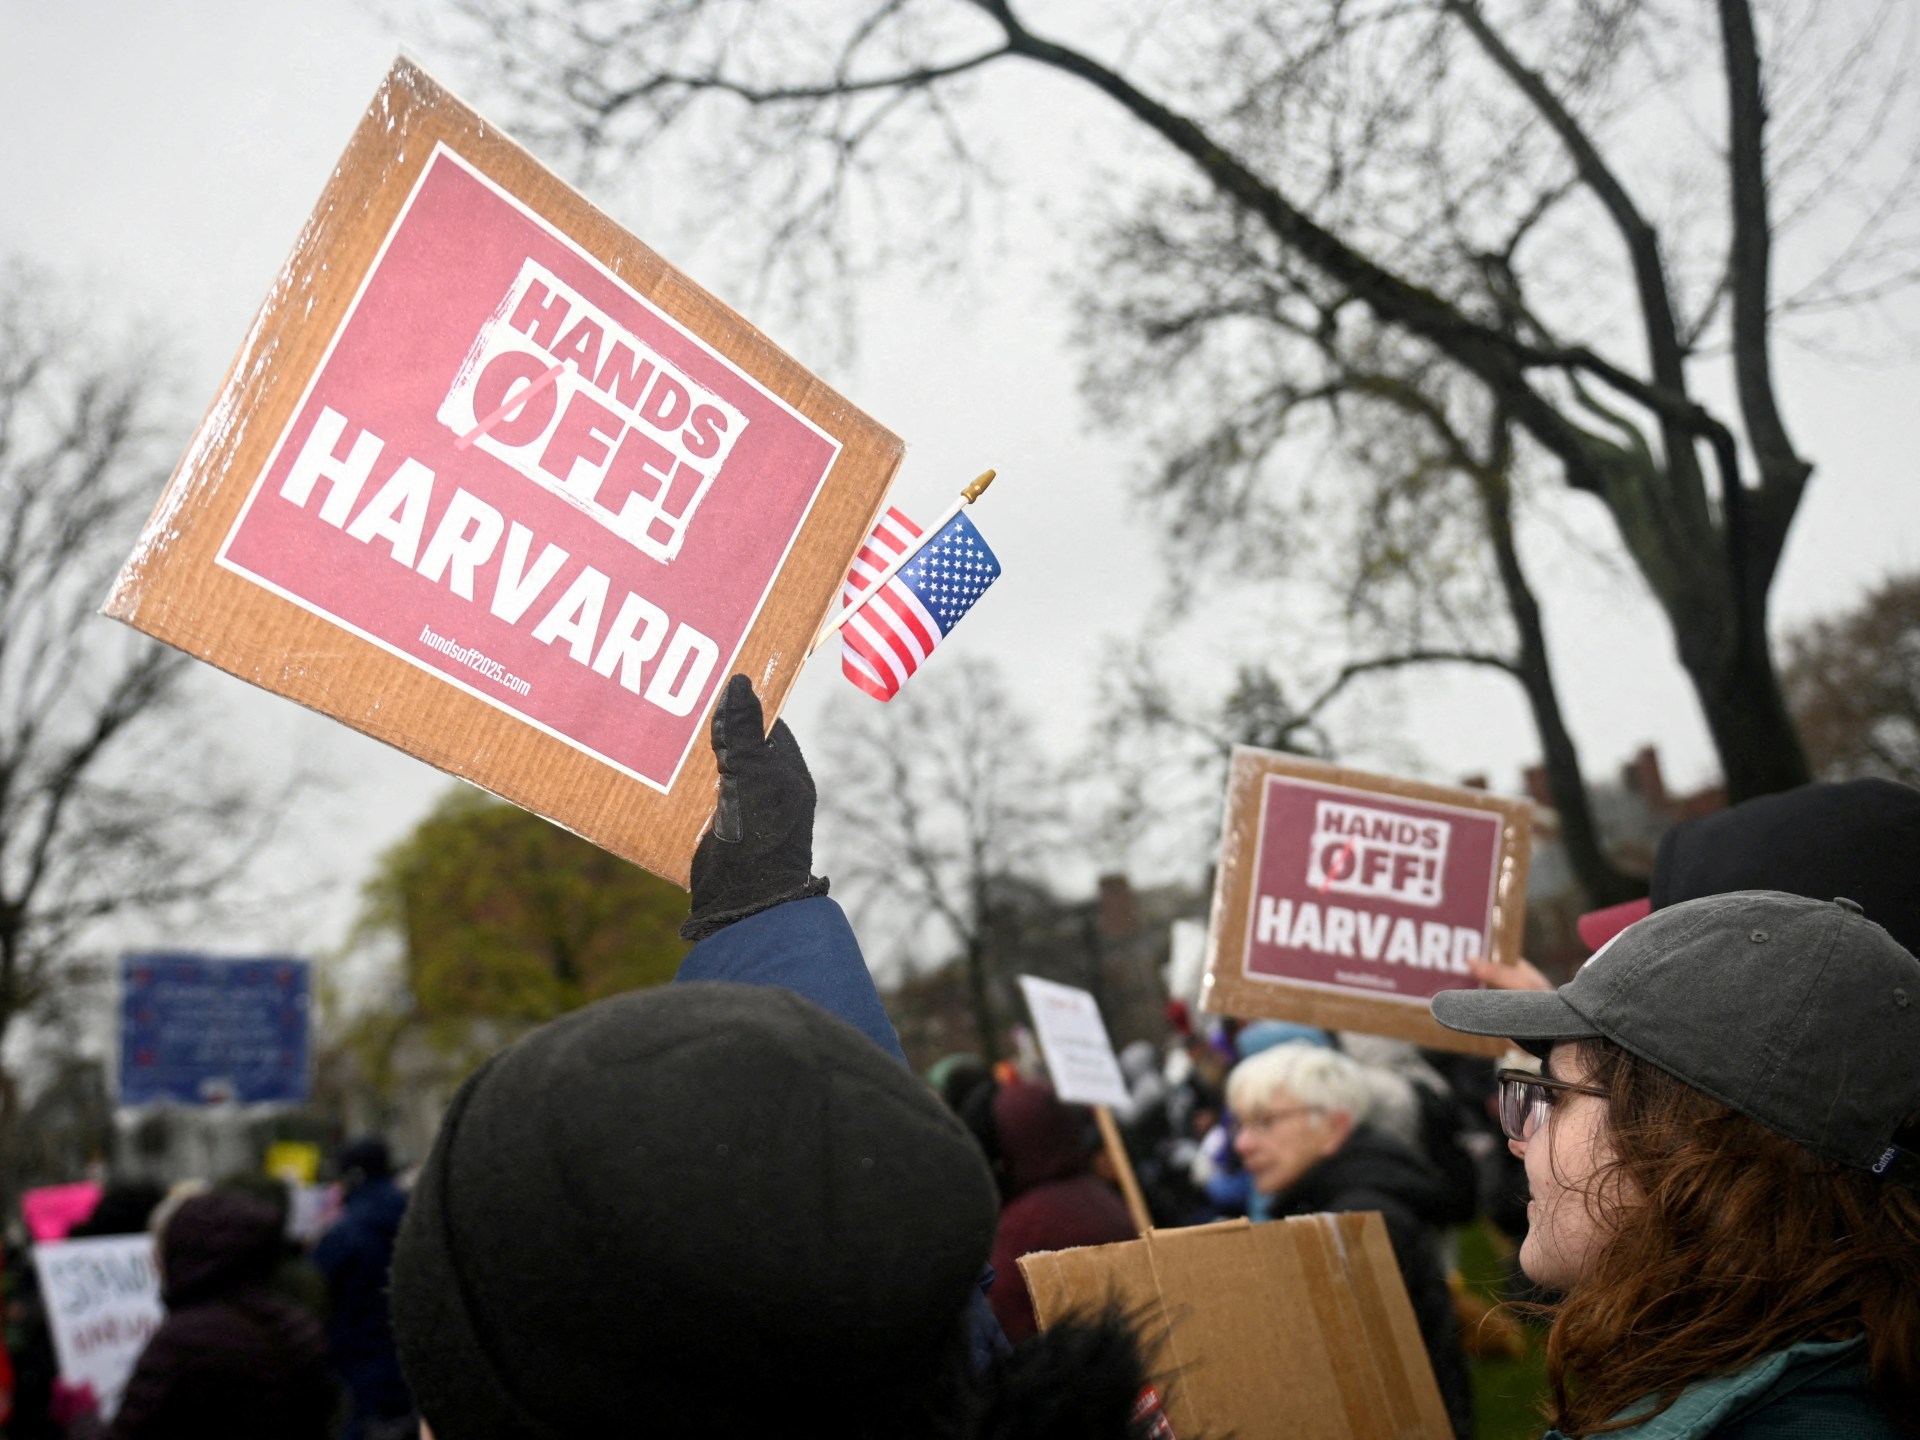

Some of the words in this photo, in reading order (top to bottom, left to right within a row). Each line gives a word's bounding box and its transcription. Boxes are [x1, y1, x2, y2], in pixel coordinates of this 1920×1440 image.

[509, 278, 728, 459] HANDS
[473, 351, 704, 546] OFF!
[279, 405, 720, 717] HARVARD
[419, 624, 531, 696] handsoff2025.com
[1320, 842, 1437, 896] OFF!
[1323, 809, 1439, 851] HANDS
[1257, 895, 1482, 976] HARVARD
